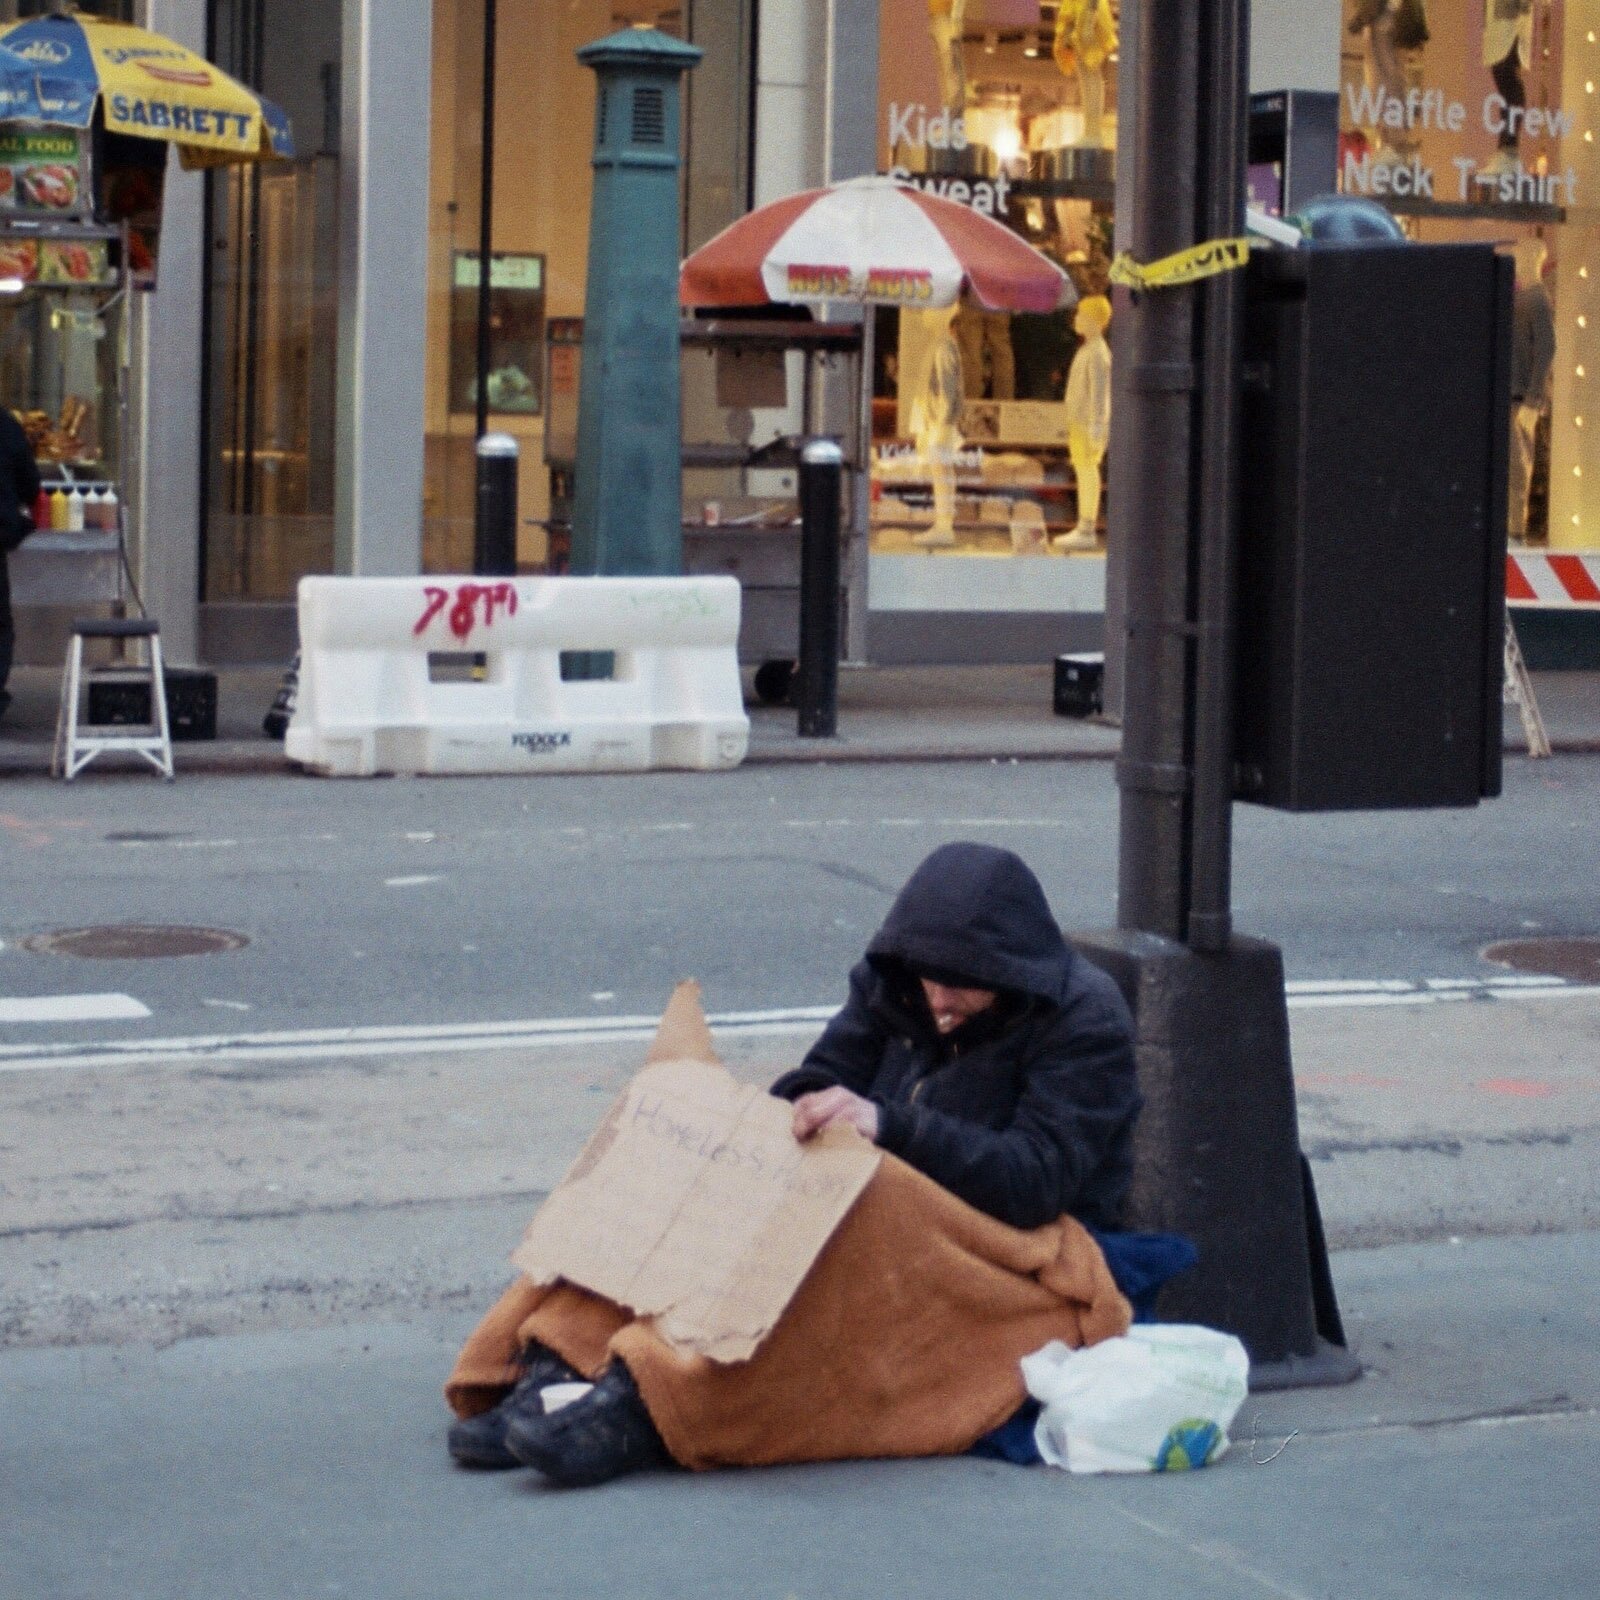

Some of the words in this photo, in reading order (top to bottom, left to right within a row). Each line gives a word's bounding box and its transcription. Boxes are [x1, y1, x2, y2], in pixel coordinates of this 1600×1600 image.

[112, 94, 252, 140] SABRETT
[888, 101, 968, 150] Kids
[1345, 83, 1466, 131] Waffle
[1482, 92, 1575, 137] Crew
[1343, 151, 1434, 196] Neck
[1452, 157, 1578, 205] T-shirt
